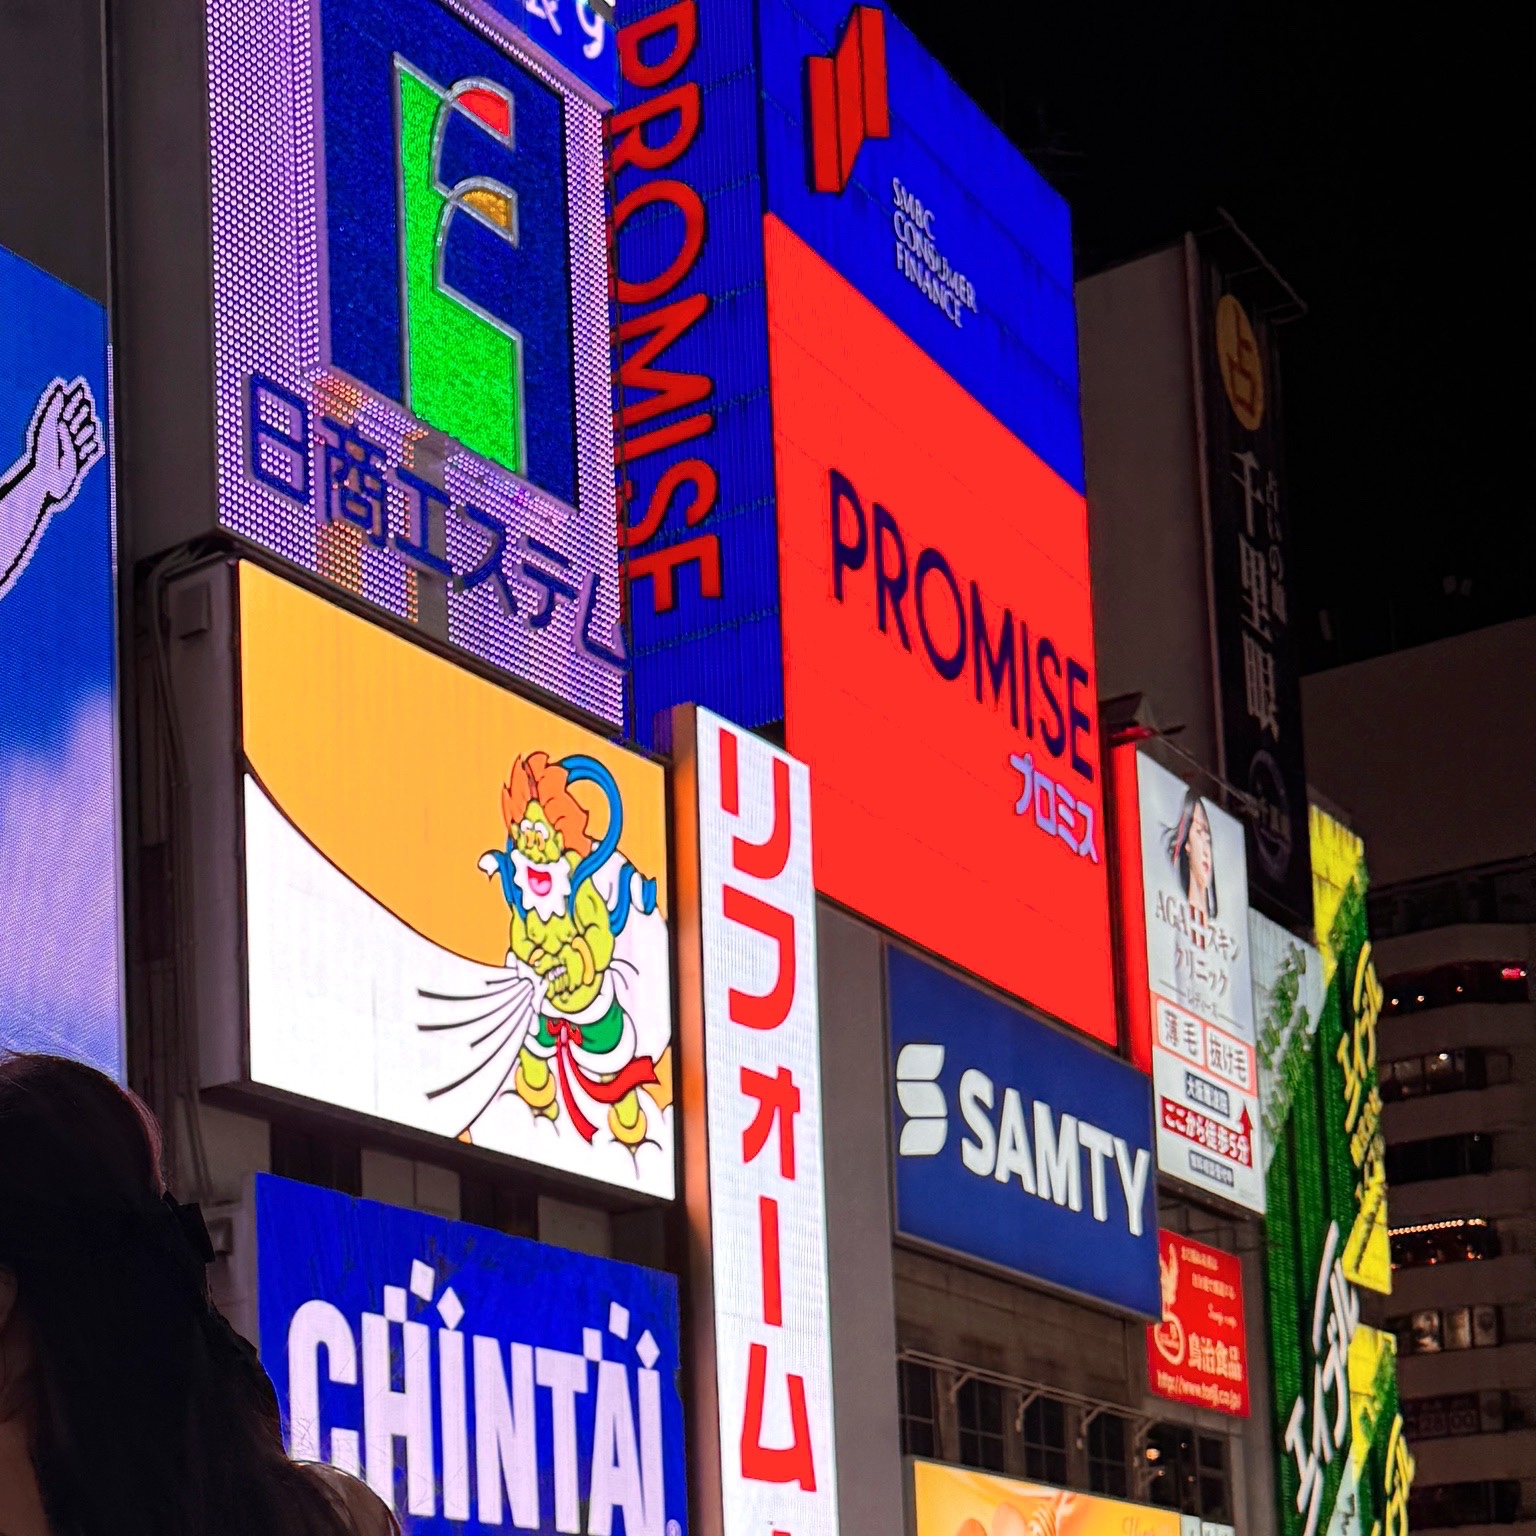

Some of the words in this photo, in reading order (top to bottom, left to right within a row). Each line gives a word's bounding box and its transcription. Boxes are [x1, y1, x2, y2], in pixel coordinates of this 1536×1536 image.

[892, 176, 936, 241] SMBC
[893, 209, 979, 314] CONSUMER
[895, 240, 964, 329] FINANCE
[829, 467, 1094, 782] PROMISE
[1010, 752, 1099, 864] プロミス
[1155, 889, 1189, 937] AGA
[1174, 944, 1229, 998] クリニック
[1164, 1008, 1199, 1057] 薄毛
[1208, 1031, 1248, 1084] 抜け毛
[959, 1067, 1151, 1238] SAMTY
[1164, 1101, 1250, 1167] ここから徒歩5分
